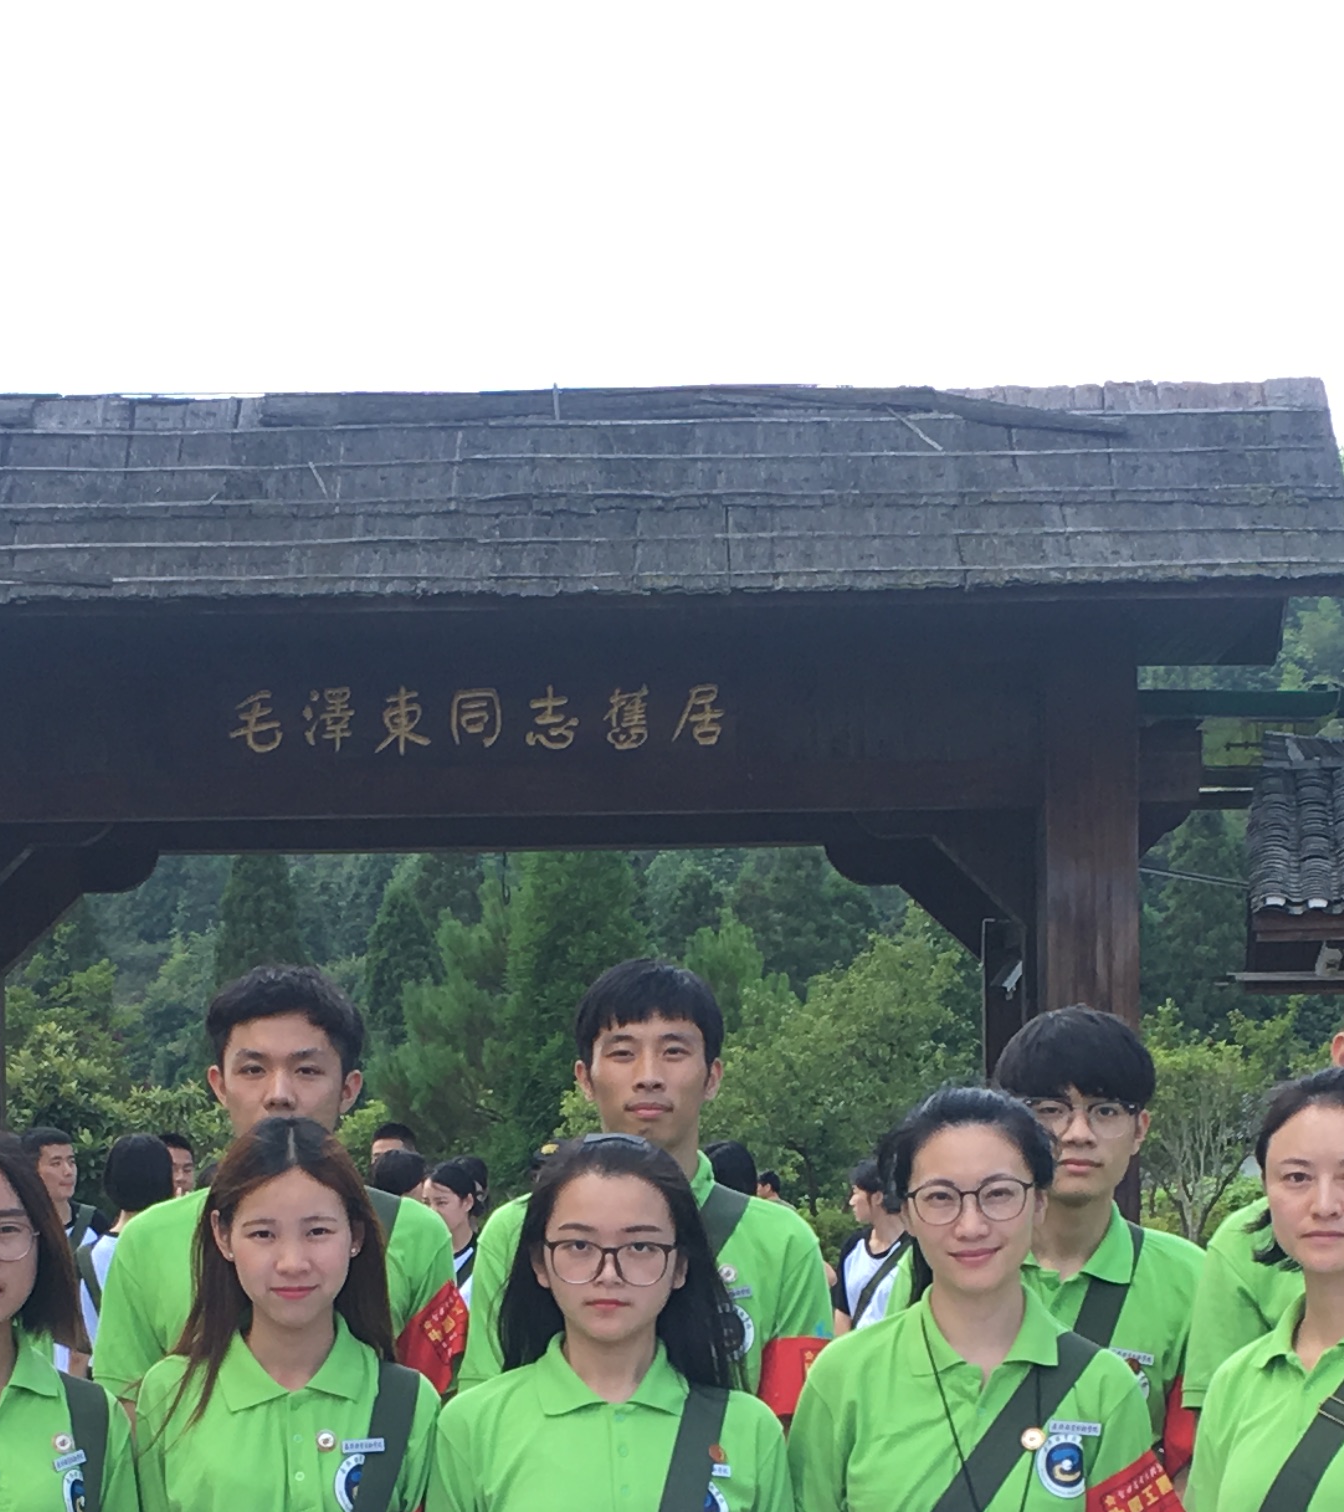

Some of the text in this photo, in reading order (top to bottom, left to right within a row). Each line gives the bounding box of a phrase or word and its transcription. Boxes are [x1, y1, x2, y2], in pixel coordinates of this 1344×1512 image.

[229, 683, 726, 756] 毛澤東同志舊居
